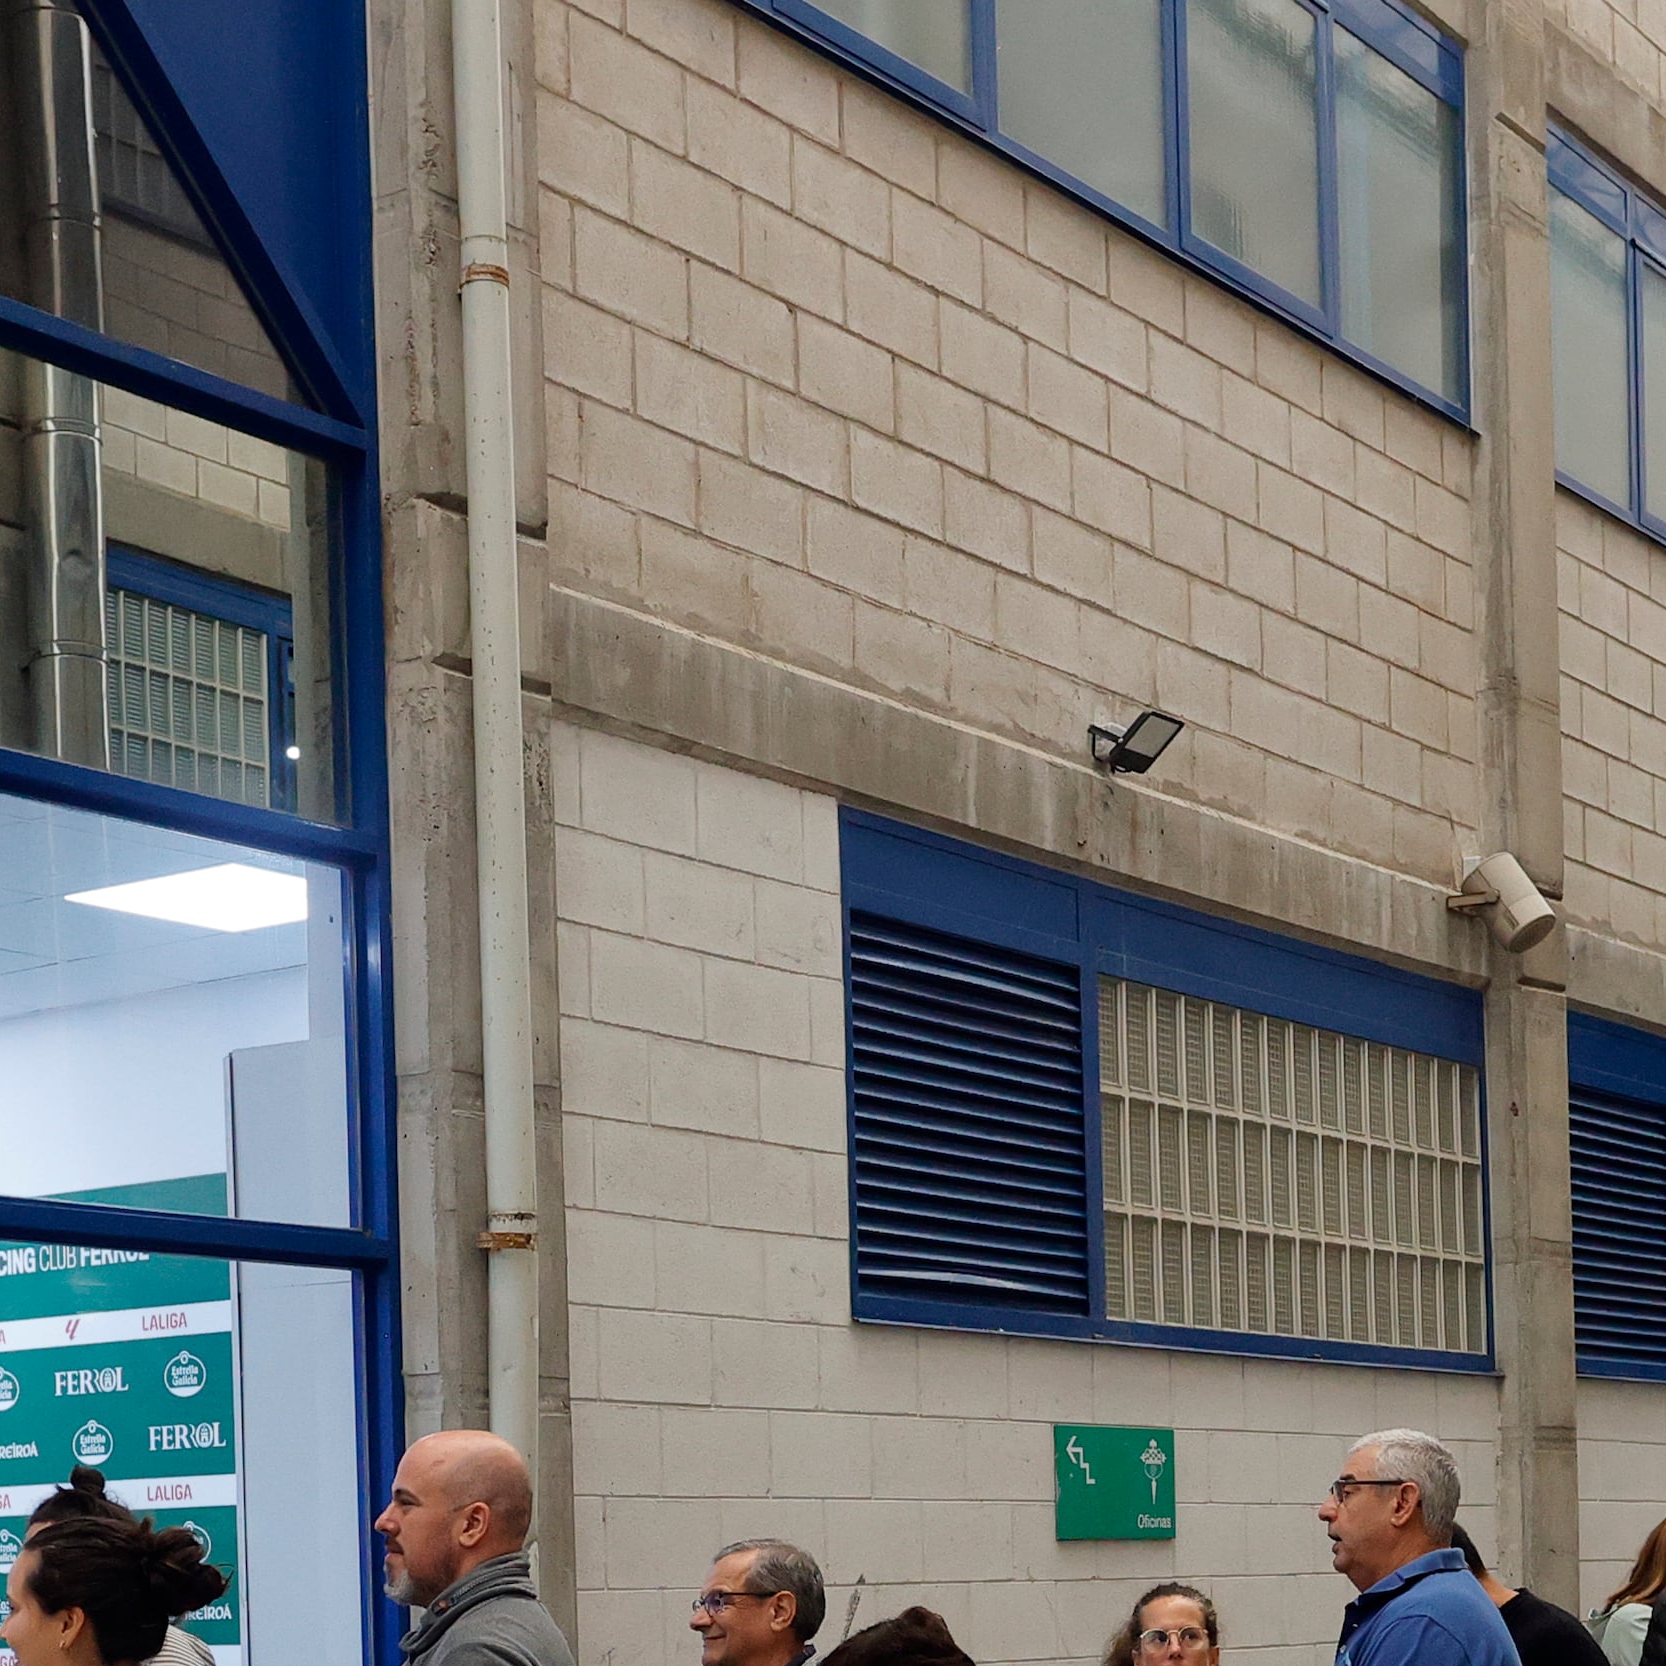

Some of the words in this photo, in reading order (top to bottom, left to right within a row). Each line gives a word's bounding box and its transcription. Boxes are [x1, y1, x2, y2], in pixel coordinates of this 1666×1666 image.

[39, 1245, 77, 1272] CLUB
[141, 1312, 188, 1332] LALIGA
[170, 1364, 199, 1377] Estrella
[53, 1367, 129, 1397] FERROL
[171, 1374, 198, 1387] Galicia
[80, 1432, 107, 1446] Estrella
[148, 1422, 227, 1452] FERROL
[80, 1442, 106, 1456] Galicia
[147, 1484, 193, 1502] LALIGA
[1137, 1514, 1172, 1529] Oficinas
